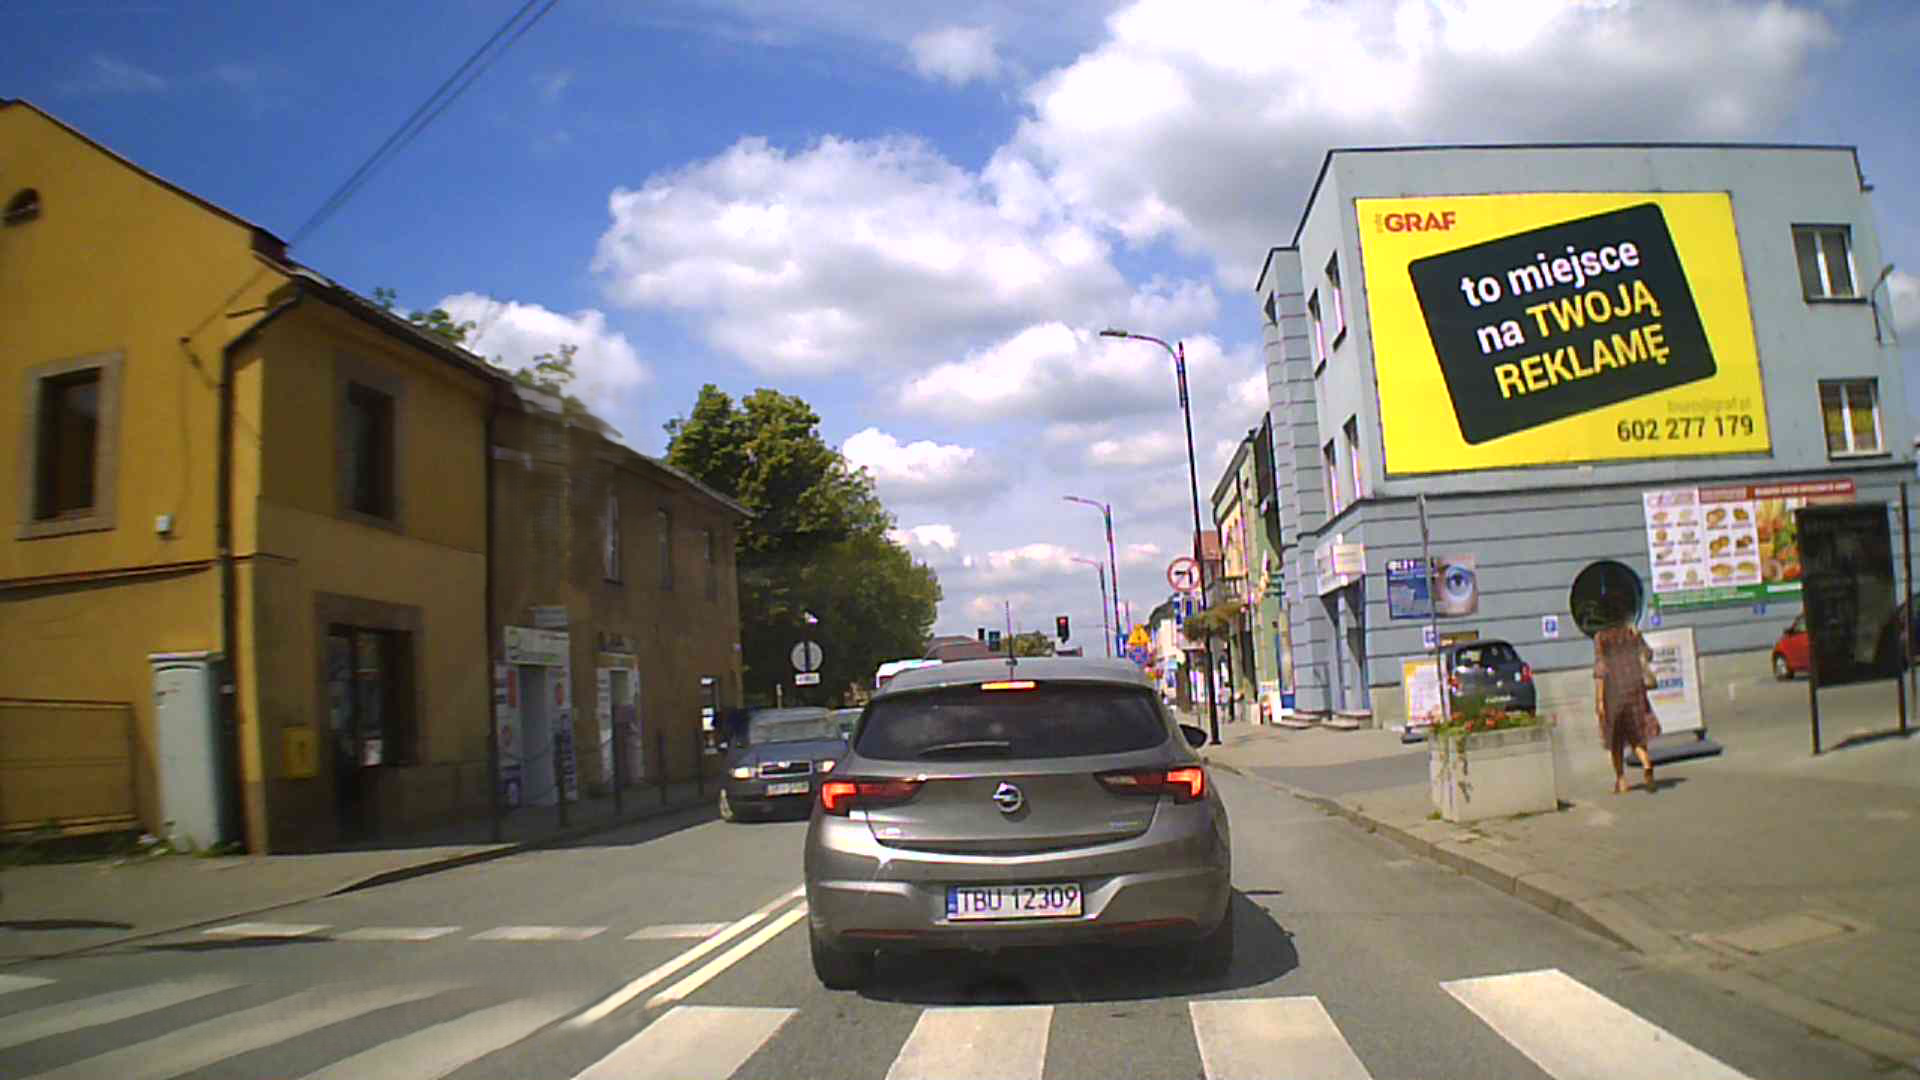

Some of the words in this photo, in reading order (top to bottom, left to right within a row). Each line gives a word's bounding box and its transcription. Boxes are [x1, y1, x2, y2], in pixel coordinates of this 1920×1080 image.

[1384, 211, 1456, 232] GRAF
[1460, 276, 1501, 307] to
[1507, 241, 1640, 296] miejsce
[1476, 319, 1525, 354] na
[1525, 279, 1662, 337] TWOJĄ
[1494, 323, 1670, 399] REKLAMĘ
[1617, 418, 1659, 442] 602
[1665, 416, 1706, 440] 277
[1714, 413, 1754, 437] 179
[959, 888, 1002, 912] TBU
[1010, 885, 1078, 910] 12309
